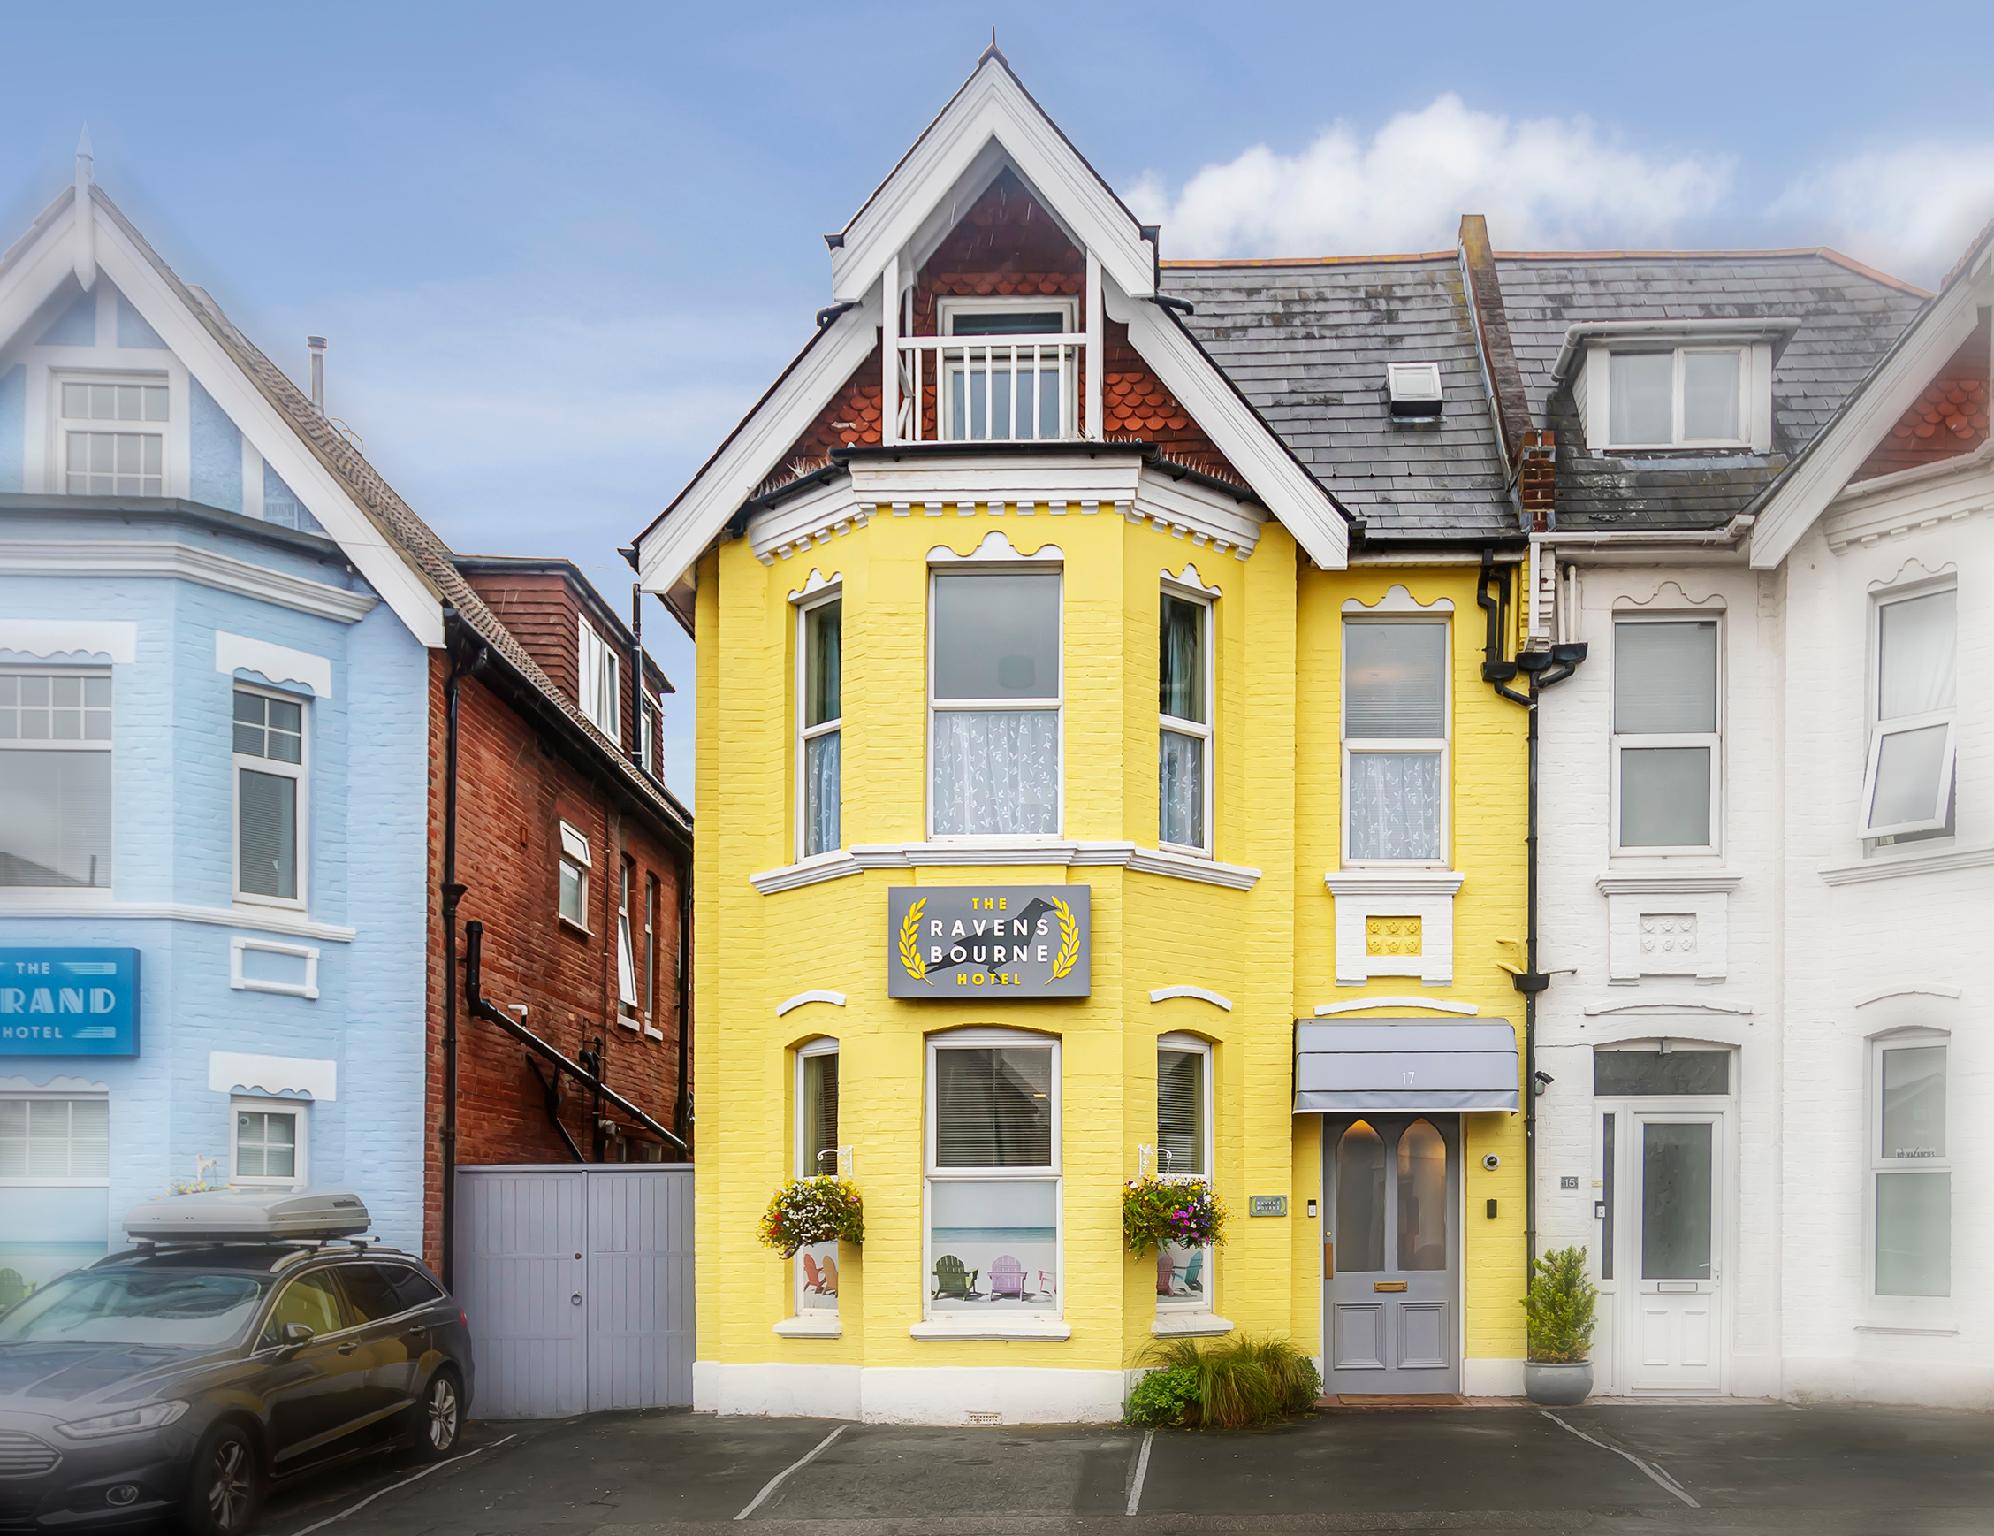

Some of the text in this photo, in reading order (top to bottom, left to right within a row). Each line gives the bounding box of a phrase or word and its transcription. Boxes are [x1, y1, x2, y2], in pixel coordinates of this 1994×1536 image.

[972, 898, 1007, 910] THE
[930, 919, 1049, 937] RAVENS
[930, 945, 1048, 963] BOURNE
[15, 962, 50, 975] THE
[957, 973, 1021, 985] HOTEL
[2, 1026, 63, 1039] HOTEL
[1402, 1071, 1415, 1085] 17
